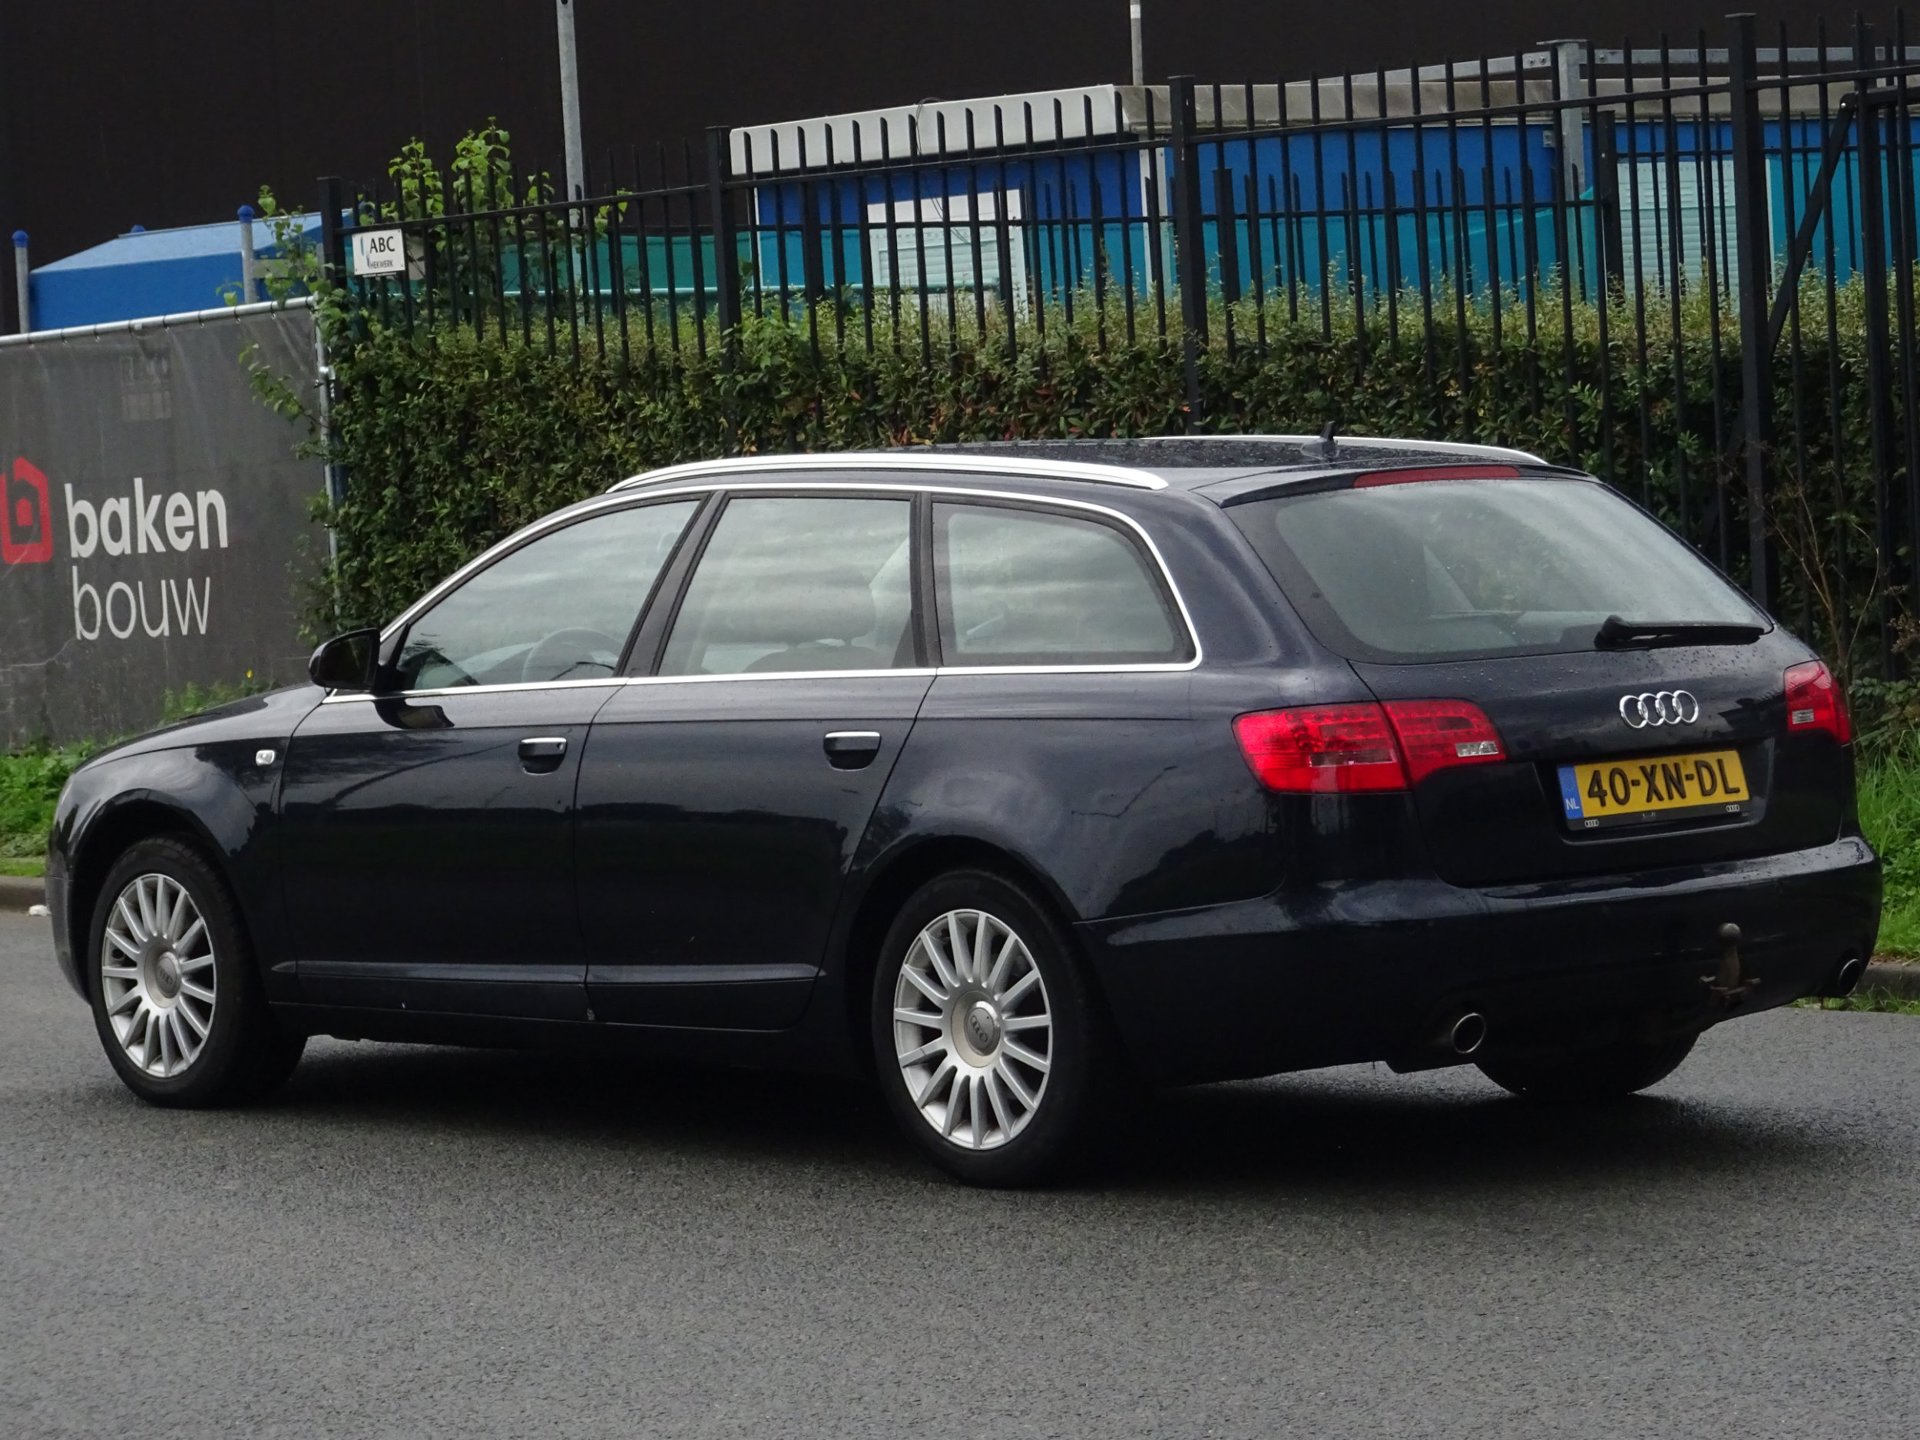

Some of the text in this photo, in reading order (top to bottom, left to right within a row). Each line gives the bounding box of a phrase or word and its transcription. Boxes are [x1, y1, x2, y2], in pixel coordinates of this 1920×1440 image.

[370, 236, 395, 254] ABC
[64, 477, 228, 558] baken
[72, 565, 210, 640] bouw
[1566, 798, 1579, 810] NL
[1588, 758, 1740, 807] 40-XN-DL
